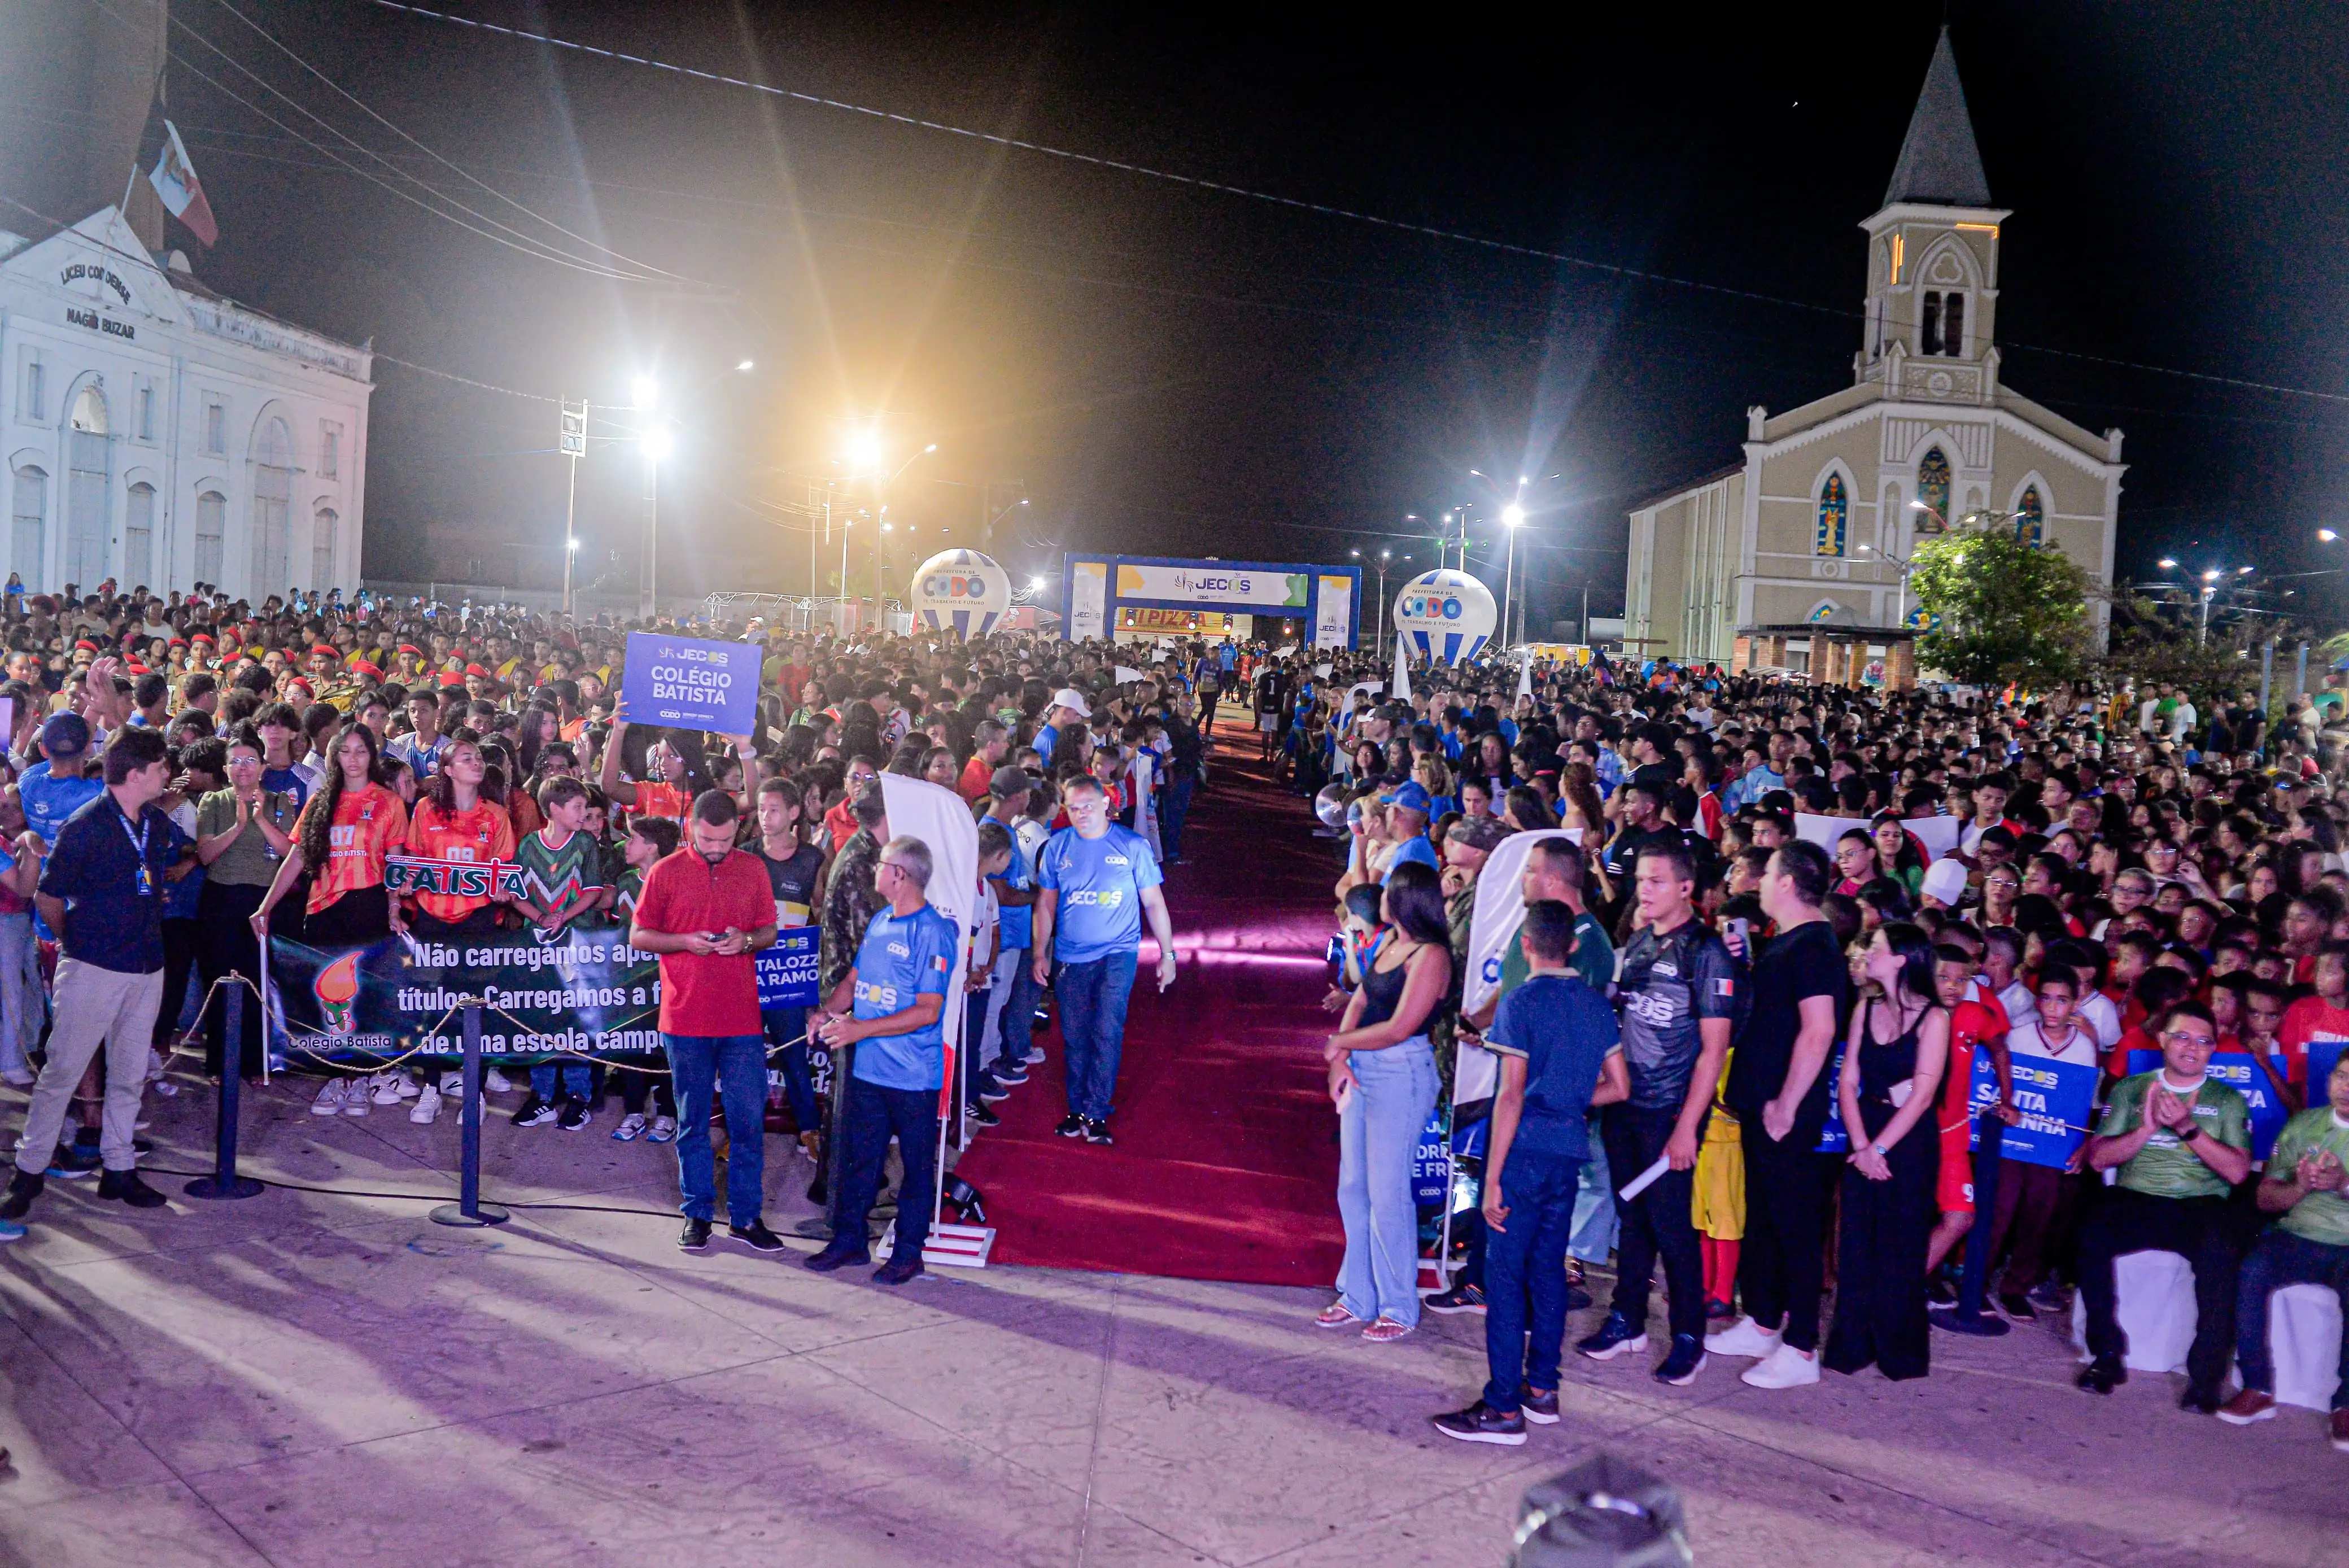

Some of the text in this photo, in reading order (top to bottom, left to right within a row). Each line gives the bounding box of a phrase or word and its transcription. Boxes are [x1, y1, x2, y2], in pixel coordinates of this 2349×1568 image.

[60, 264, 85, 285] LICEU
[102, 318, 135, 339] BUZAR
[677, 648, 728, 663] JECOS
[651, 665, 732, 688] COLÉGIO
[653, 683, 726, 705] BATISTA
[330, 826, 355, 846] 07
[415, 943, 459, 967] Não
[465, 945, 606, 972] carregamos
[484, 985, 627, 1015] Carregamos
[632, 987, 646, 1005] a
[288, 1035, 391, 1050] Colégio Batista
[421, 1030, 449, 1054] de
[512, 1027, 589, 1051] escola
